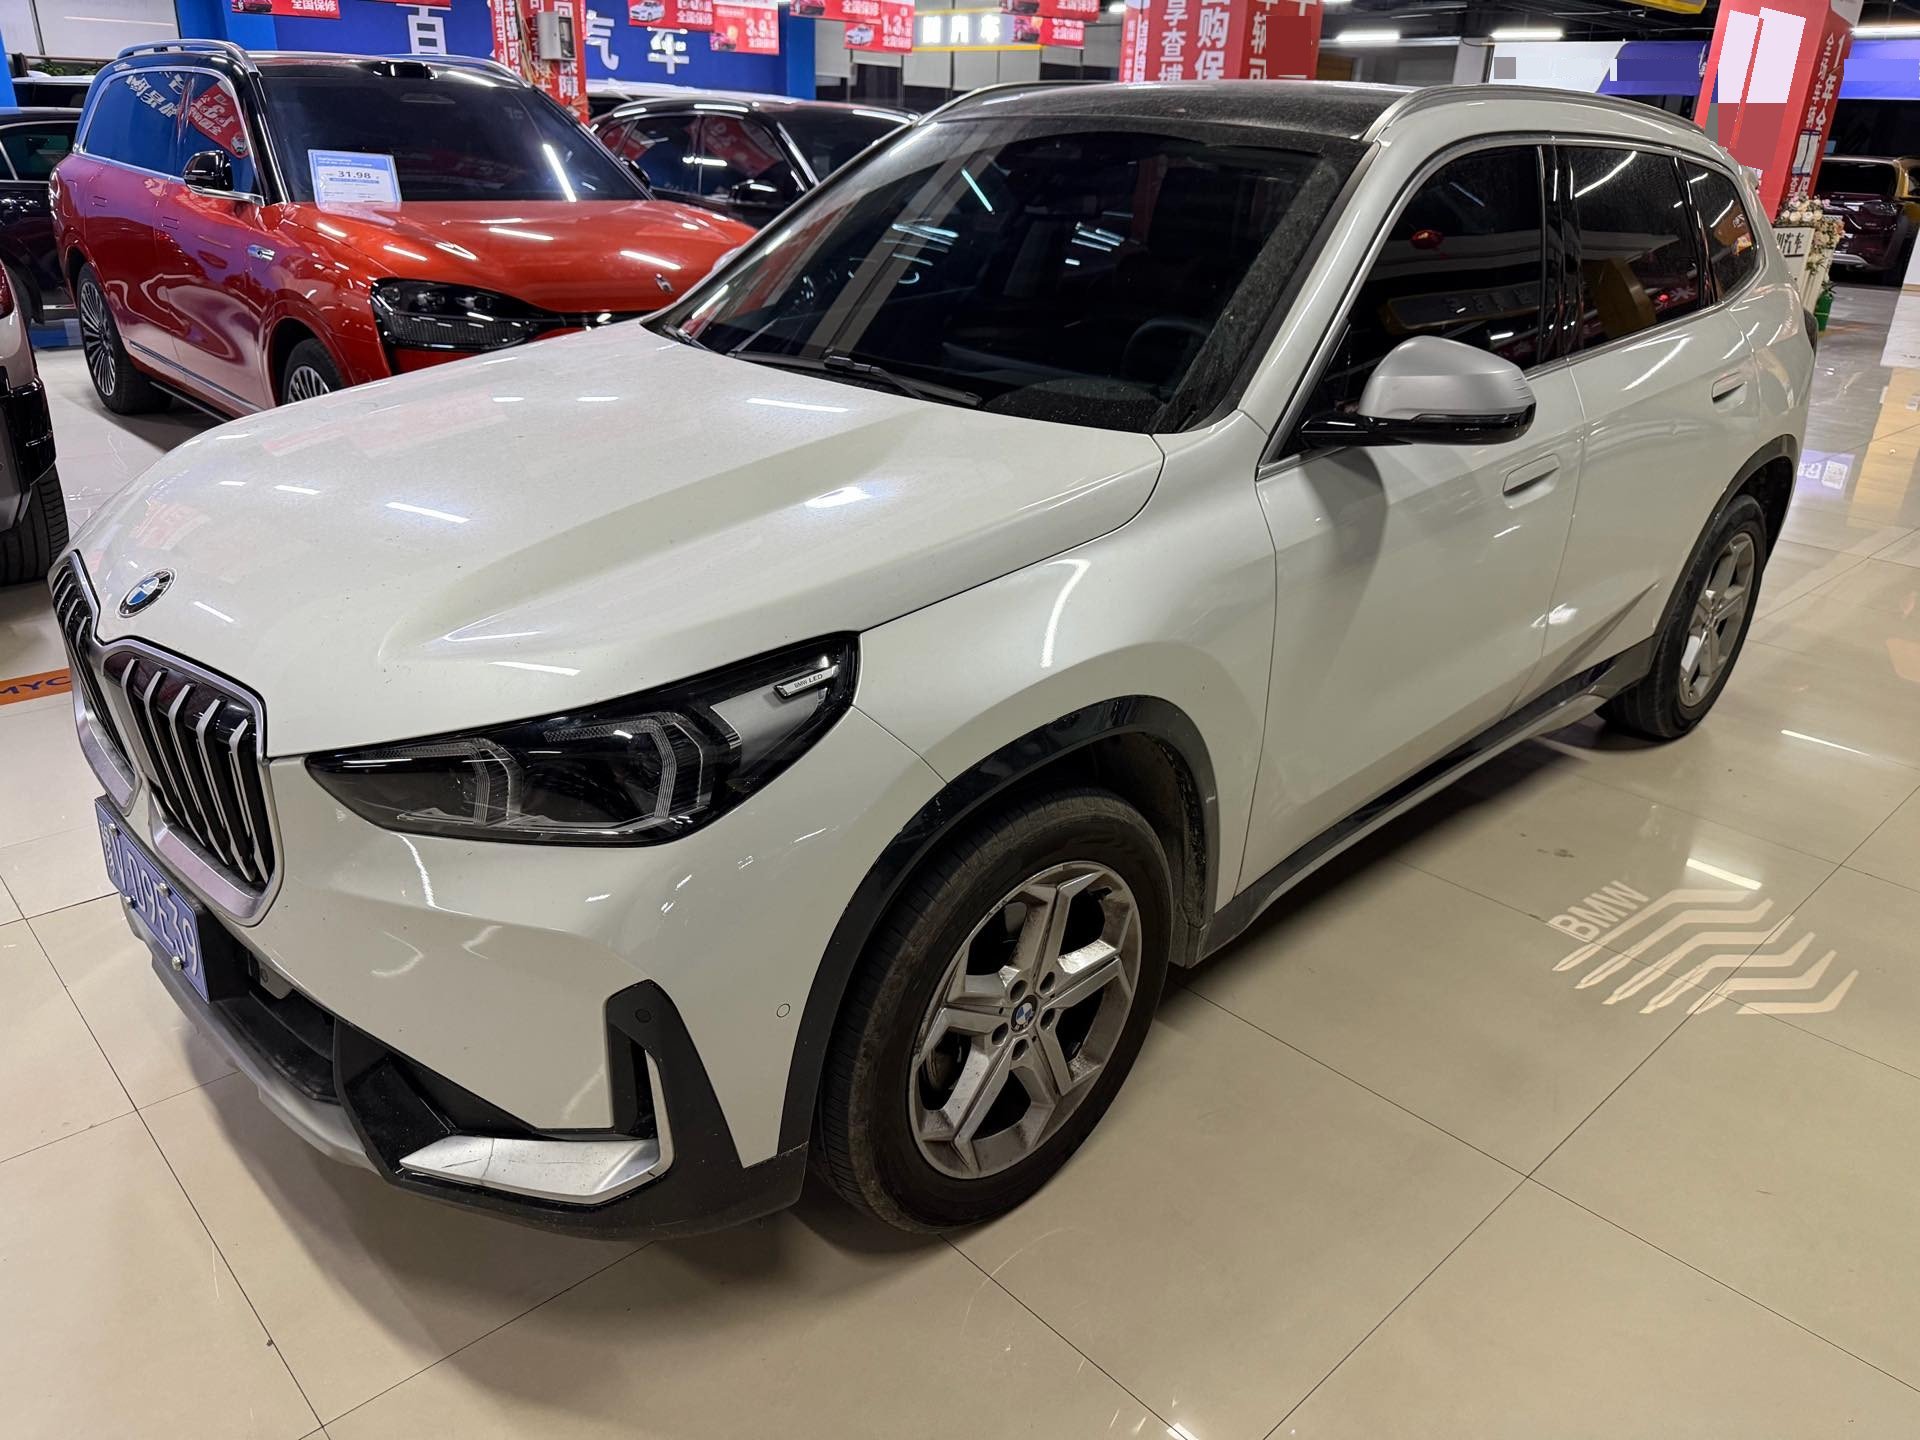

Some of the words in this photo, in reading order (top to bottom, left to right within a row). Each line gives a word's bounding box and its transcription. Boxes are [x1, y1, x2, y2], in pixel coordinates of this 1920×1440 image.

[291, 0, 336, 12] 全国保修
[337, 170, 372, 179] 31.98
[808, 673, 823, 683] LED
[1545, 880, 1649, 942] BMW
